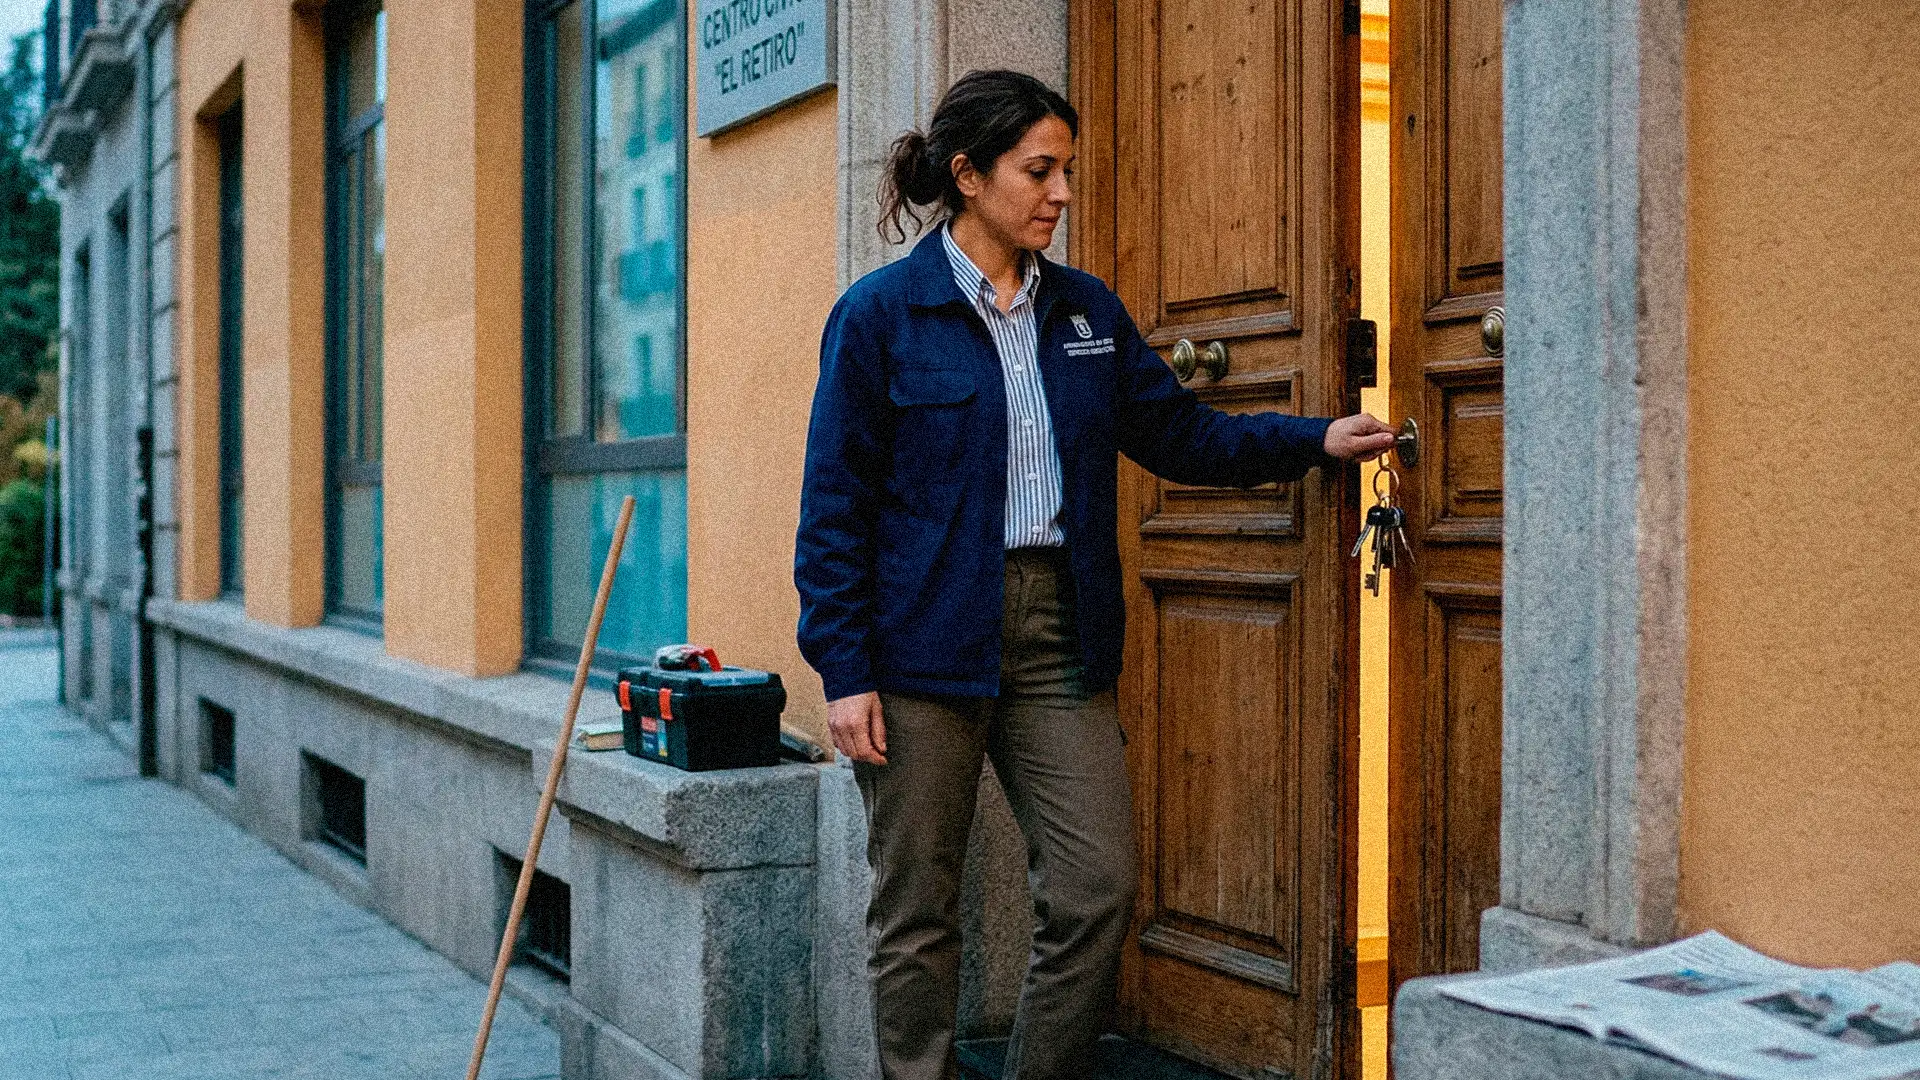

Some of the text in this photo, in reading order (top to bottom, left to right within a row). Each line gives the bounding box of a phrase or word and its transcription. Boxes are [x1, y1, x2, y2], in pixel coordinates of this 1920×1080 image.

[704, 0, 760, 49] CENTRO
[715, 21, 805, 94] "EL RETIRO"
